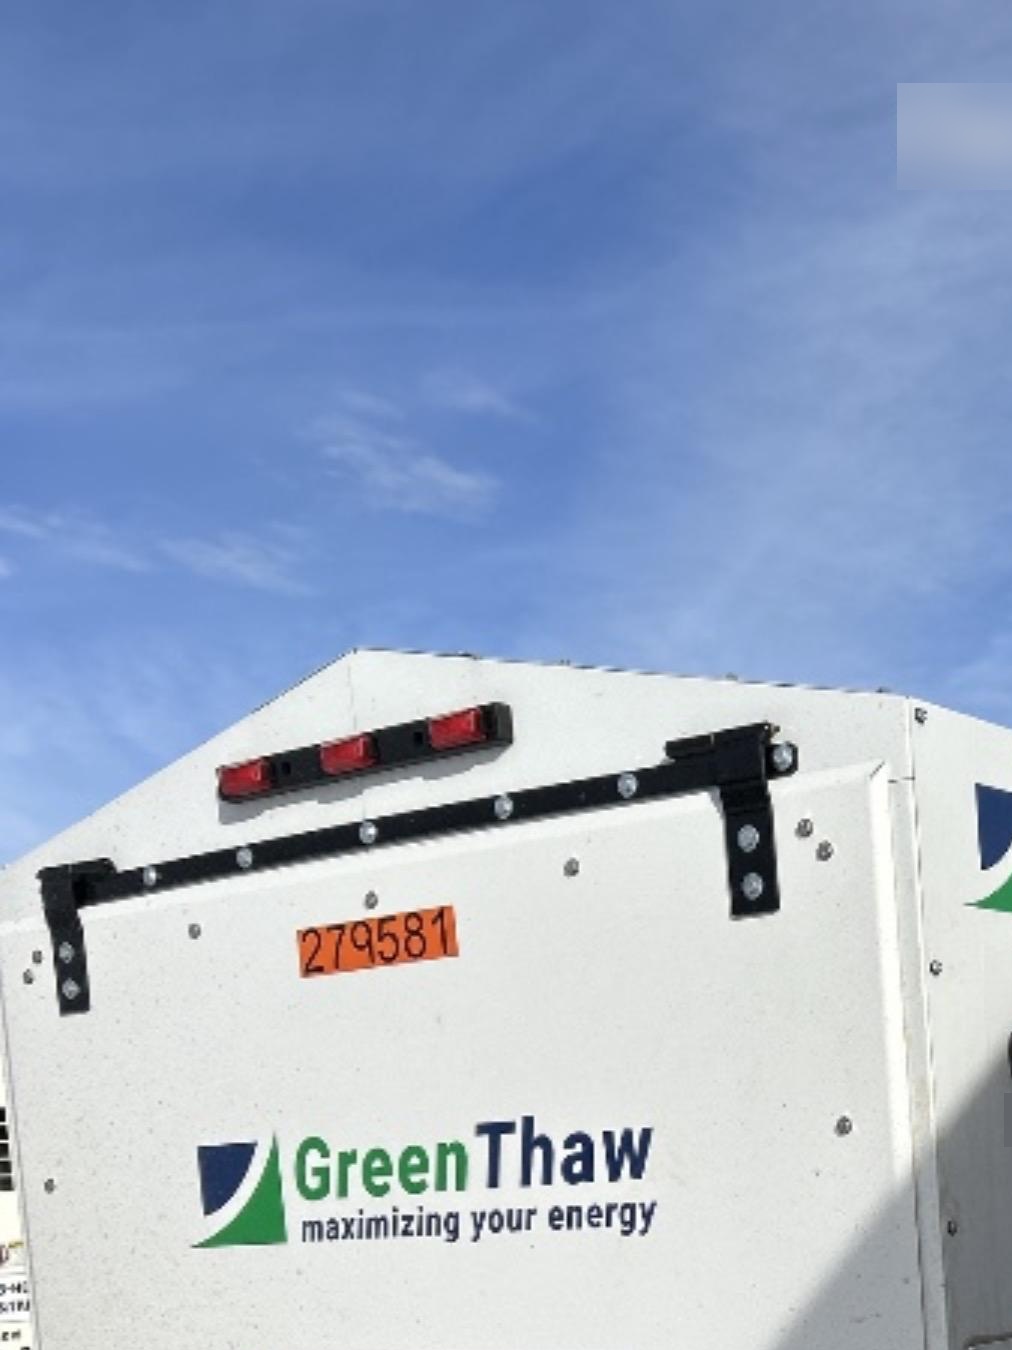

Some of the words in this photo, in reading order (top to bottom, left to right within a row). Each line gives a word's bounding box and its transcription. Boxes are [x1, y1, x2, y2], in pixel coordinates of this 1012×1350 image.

[301, 906, 453, 974] 279581
[295, 1116, 654, 1200] GreenThaw
[302, 1207, 460, 1243] maximizing
[471, 1203, 538, 1242] your
[548, 1200, 657, 1236] energy
